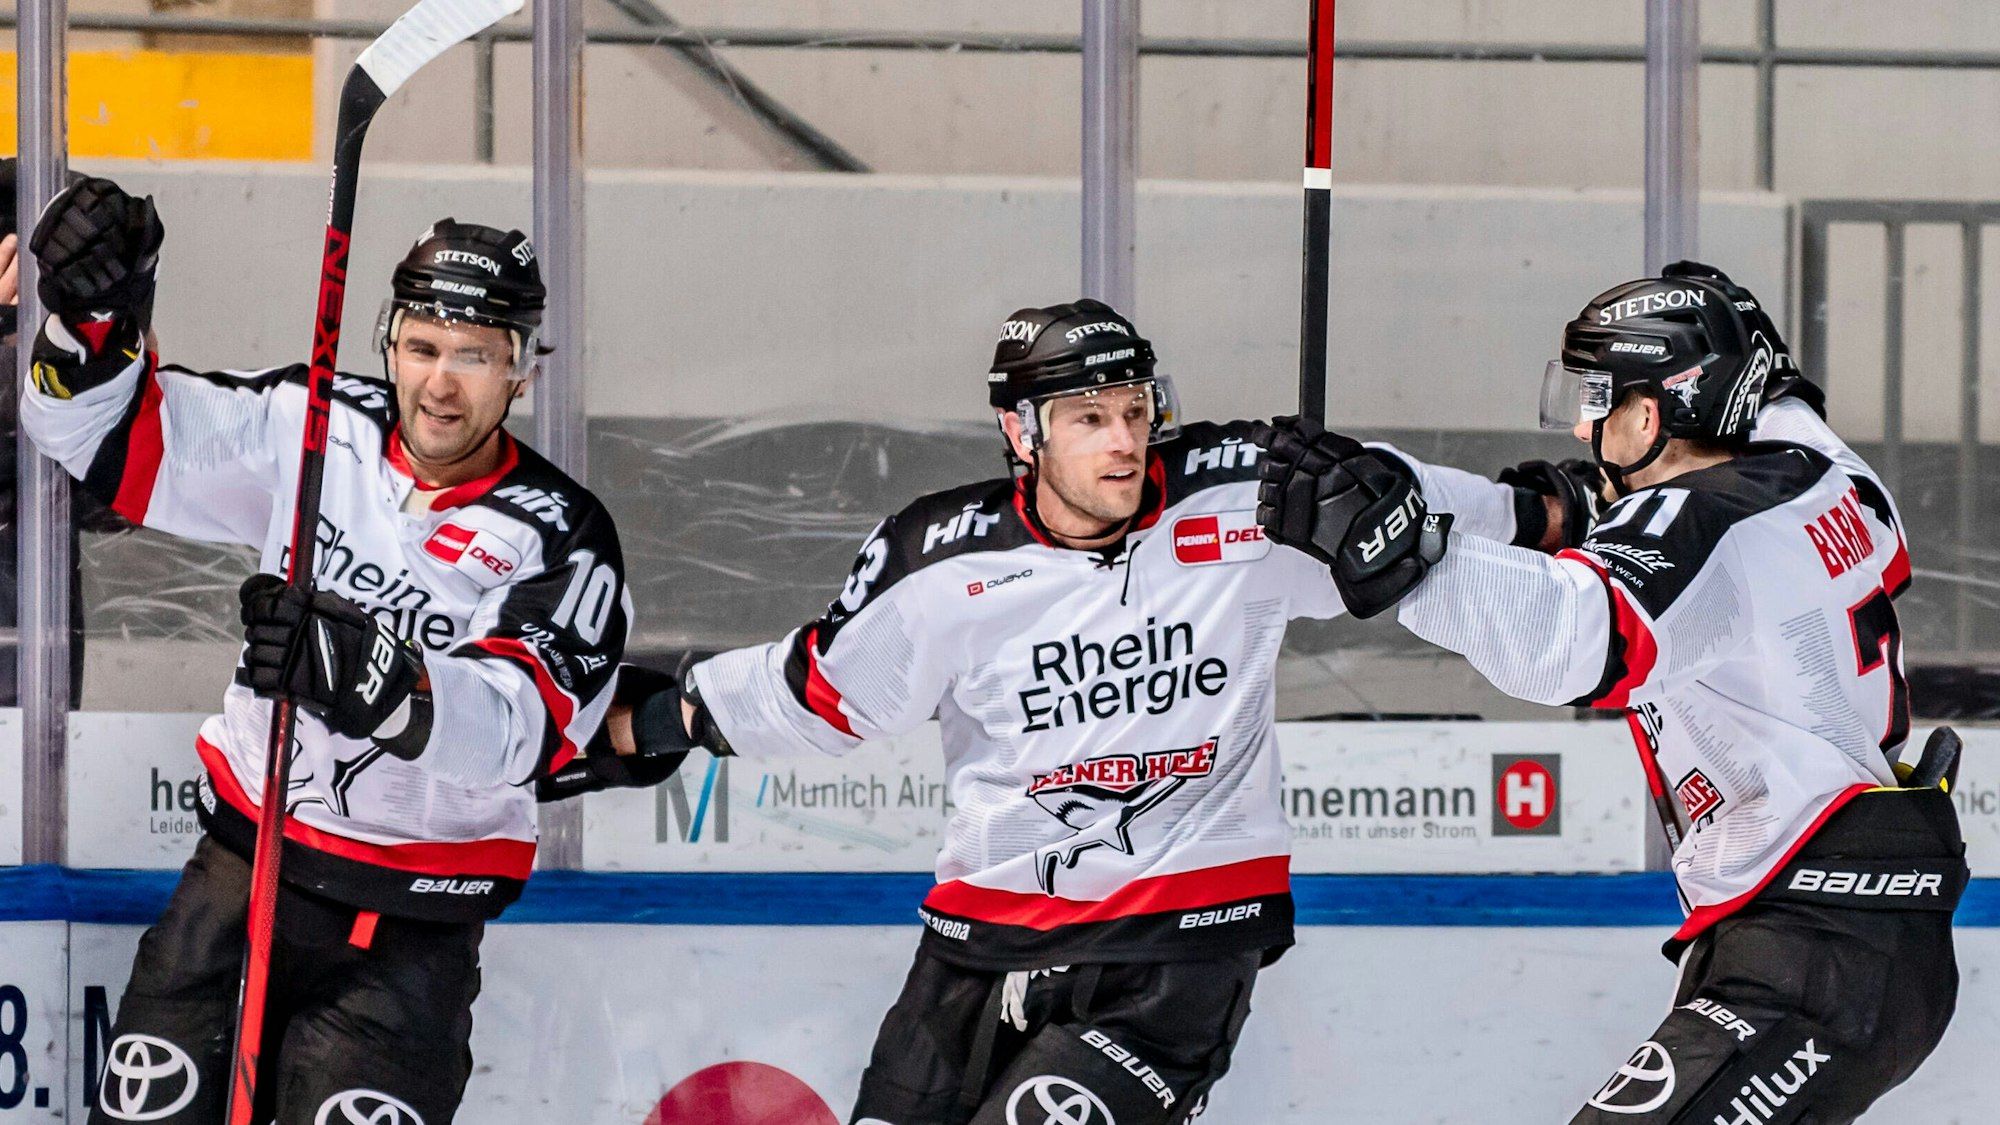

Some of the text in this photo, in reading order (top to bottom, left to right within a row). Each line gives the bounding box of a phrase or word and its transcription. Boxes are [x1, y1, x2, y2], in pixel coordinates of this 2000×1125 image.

[434, 249, 502, 277] STETSON
[430, 279, 487, 298] BAUER
[1600, 289, 1706, 326] STETSON
[303, 228, 350, 454] NEXUS
[1065, 321, 1129, 344] STETSON
[1085, 347, 1135, 367] BAUER
[1610, 341, 1667, 356] BAUER
[1184, 437, 1268, 476] HIT
[922, 500, 1000, 554] HIT
[1615, 566, 1645, 589] WEAR
[551, 548, 617, 647] 10
[1032, 617, 1193, 687] Rhein
[1018, 657, 1228, 734] Energie
[1340, 823, 1360, 839] ist
[1367, 823, 1417, 839] unser
[1423, 822, 1476, 839] Strom
[409, 878, 495, 895] BAUER
[1788, 868, 1943, 897] BAUER
[1179, 902, 1262, 930] BAUER
[1080, 1029, 1176, 1110] BAUER
[1713, 1037, 1832, 1125] Hilux
